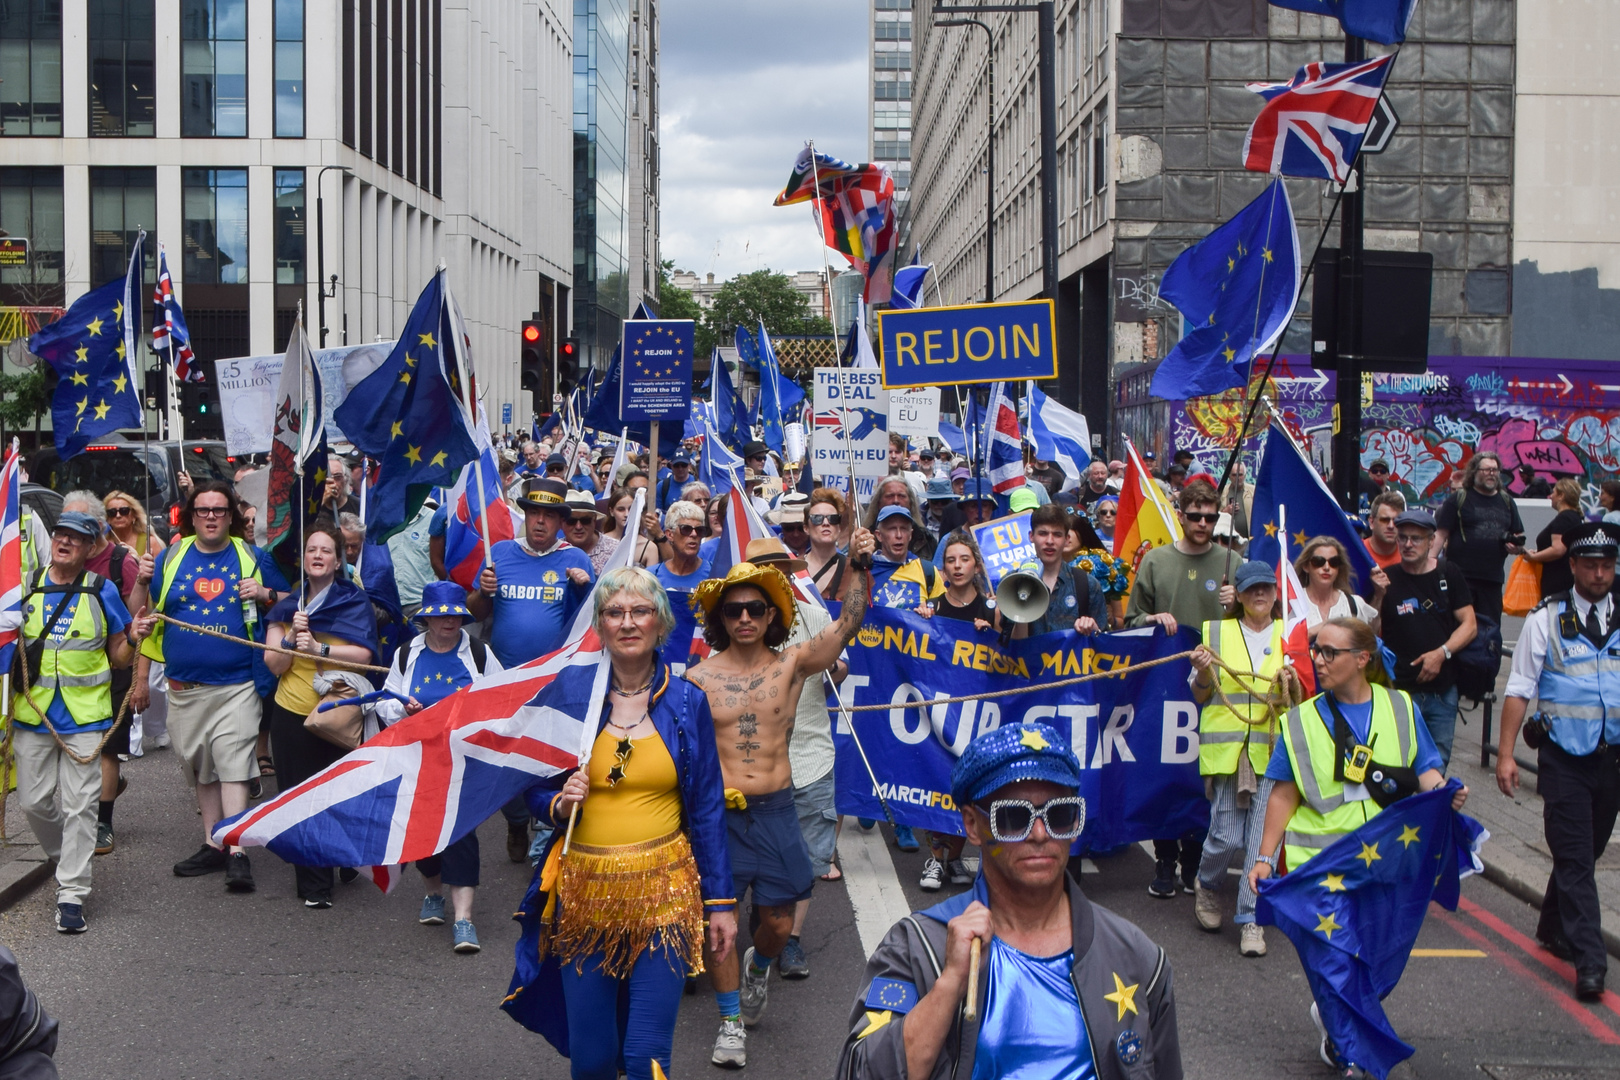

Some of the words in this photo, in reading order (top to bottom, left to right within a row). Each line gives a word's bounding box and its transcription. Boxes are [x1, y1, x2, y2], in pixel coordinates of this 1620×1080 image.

[895, 323, 1040, 367] REJOIN
[222, 361, 241, 379] £5
[220, 376, 272, 391] MILLION
[817, 372, 847, 384] THE
[849, 373, 883, 385] BEST
[828, 385, 876, 399] DEAL
[890, 395, 933, 406] CIENTISTS
[899, 409, 918, 422] EU
[815, 449, 827, 460] IS
[829, 449, 864, 460] WITH
[866, 449, 886, 460] EU
[992, 521, 1022, 550] EU
[988, 543, 1037, 567] TURN
[198, 582, 221, 593] EU
[54, 625, 66, 633] for
[861, 634, 880, 644] NRM
[1039, 647, 1131, 680] MARCH
[1160, 700, 1200, 764] B
[871, 782, 961, 812] MARCHFO
